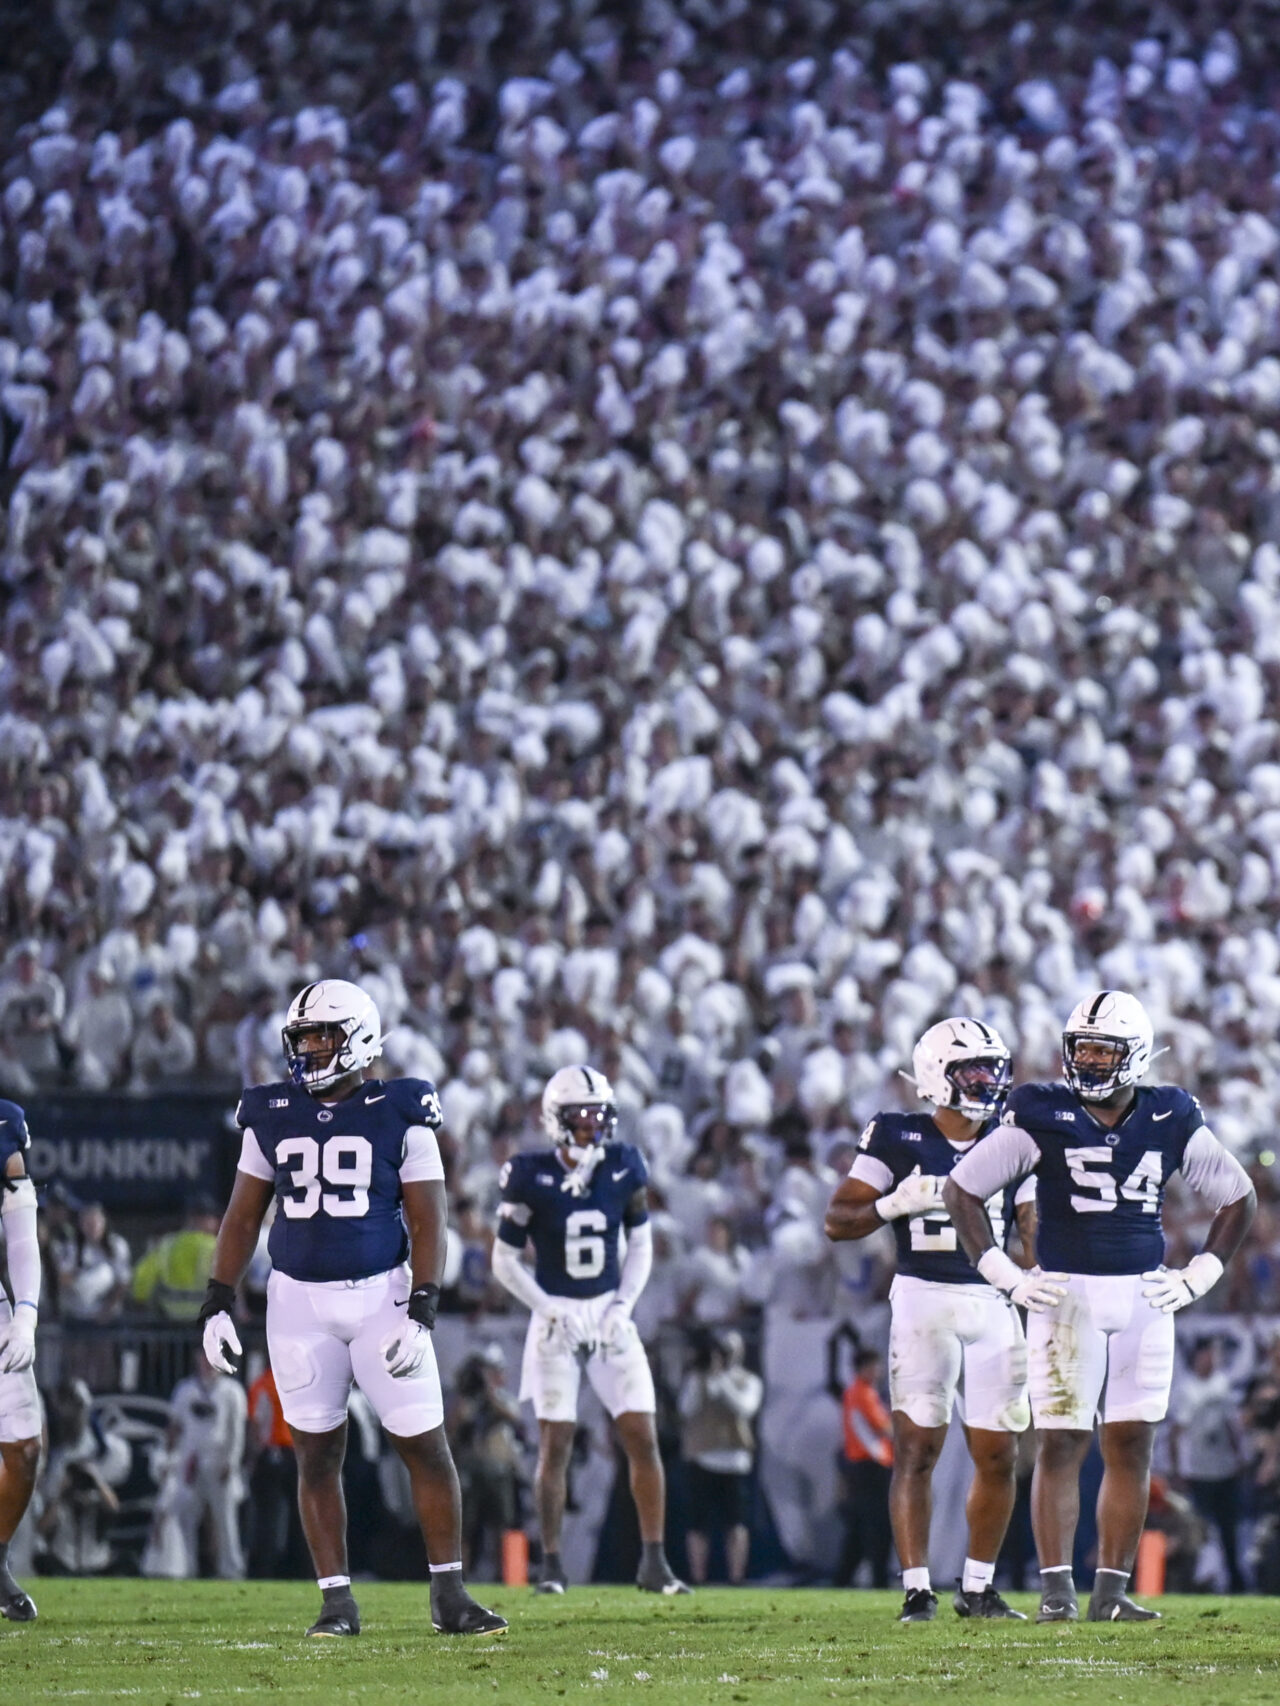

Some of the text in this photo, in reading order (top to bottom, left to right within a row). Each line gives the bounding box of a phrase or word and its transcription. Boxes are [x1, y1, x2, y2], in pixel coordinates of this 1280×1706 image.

[275, 1135, 373, 1219] 39
[1063, 1146, 1163, 1213] 54
[564, 1209, 608, 1280] 6
